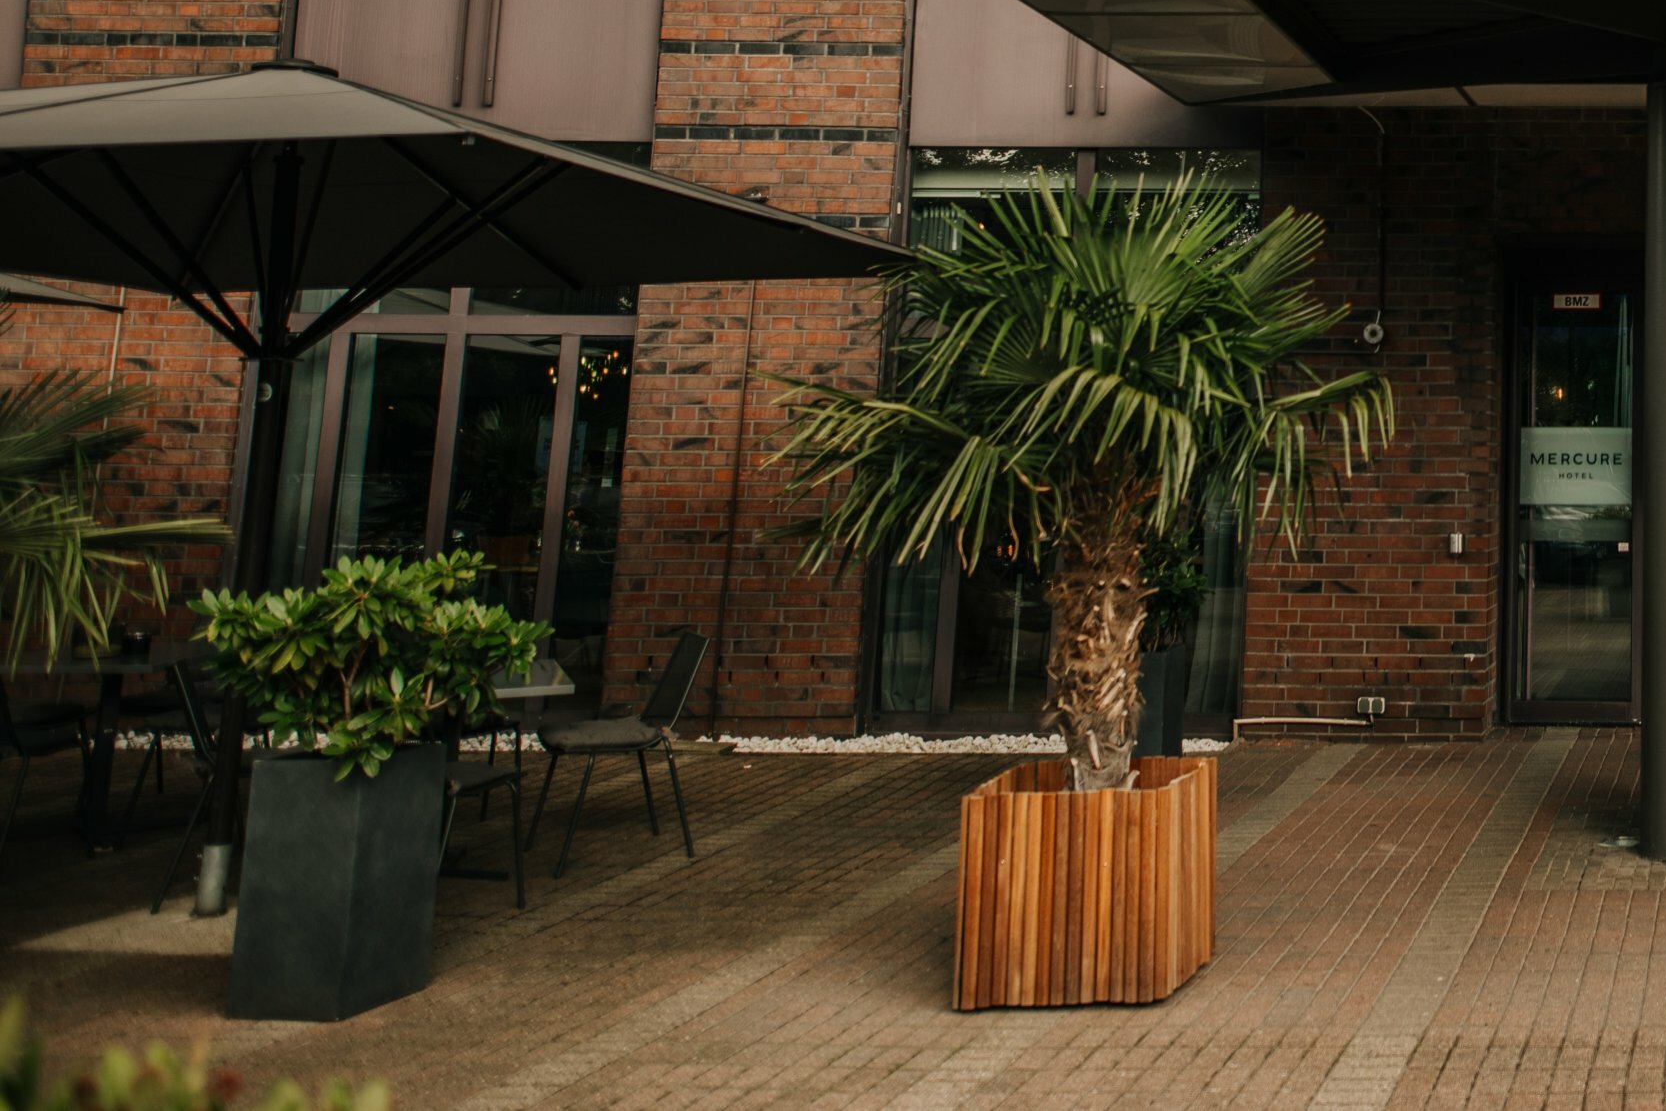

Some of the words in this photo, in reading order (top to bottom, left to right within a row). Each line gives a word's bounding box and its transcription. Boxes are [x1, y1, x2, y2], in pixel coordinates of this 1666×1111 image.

[1564, 296, 1590, 307] BMZ
[1529, 452, 1623, 466] MERCURE
[1558, 472, 1594, 480] HOTEL
